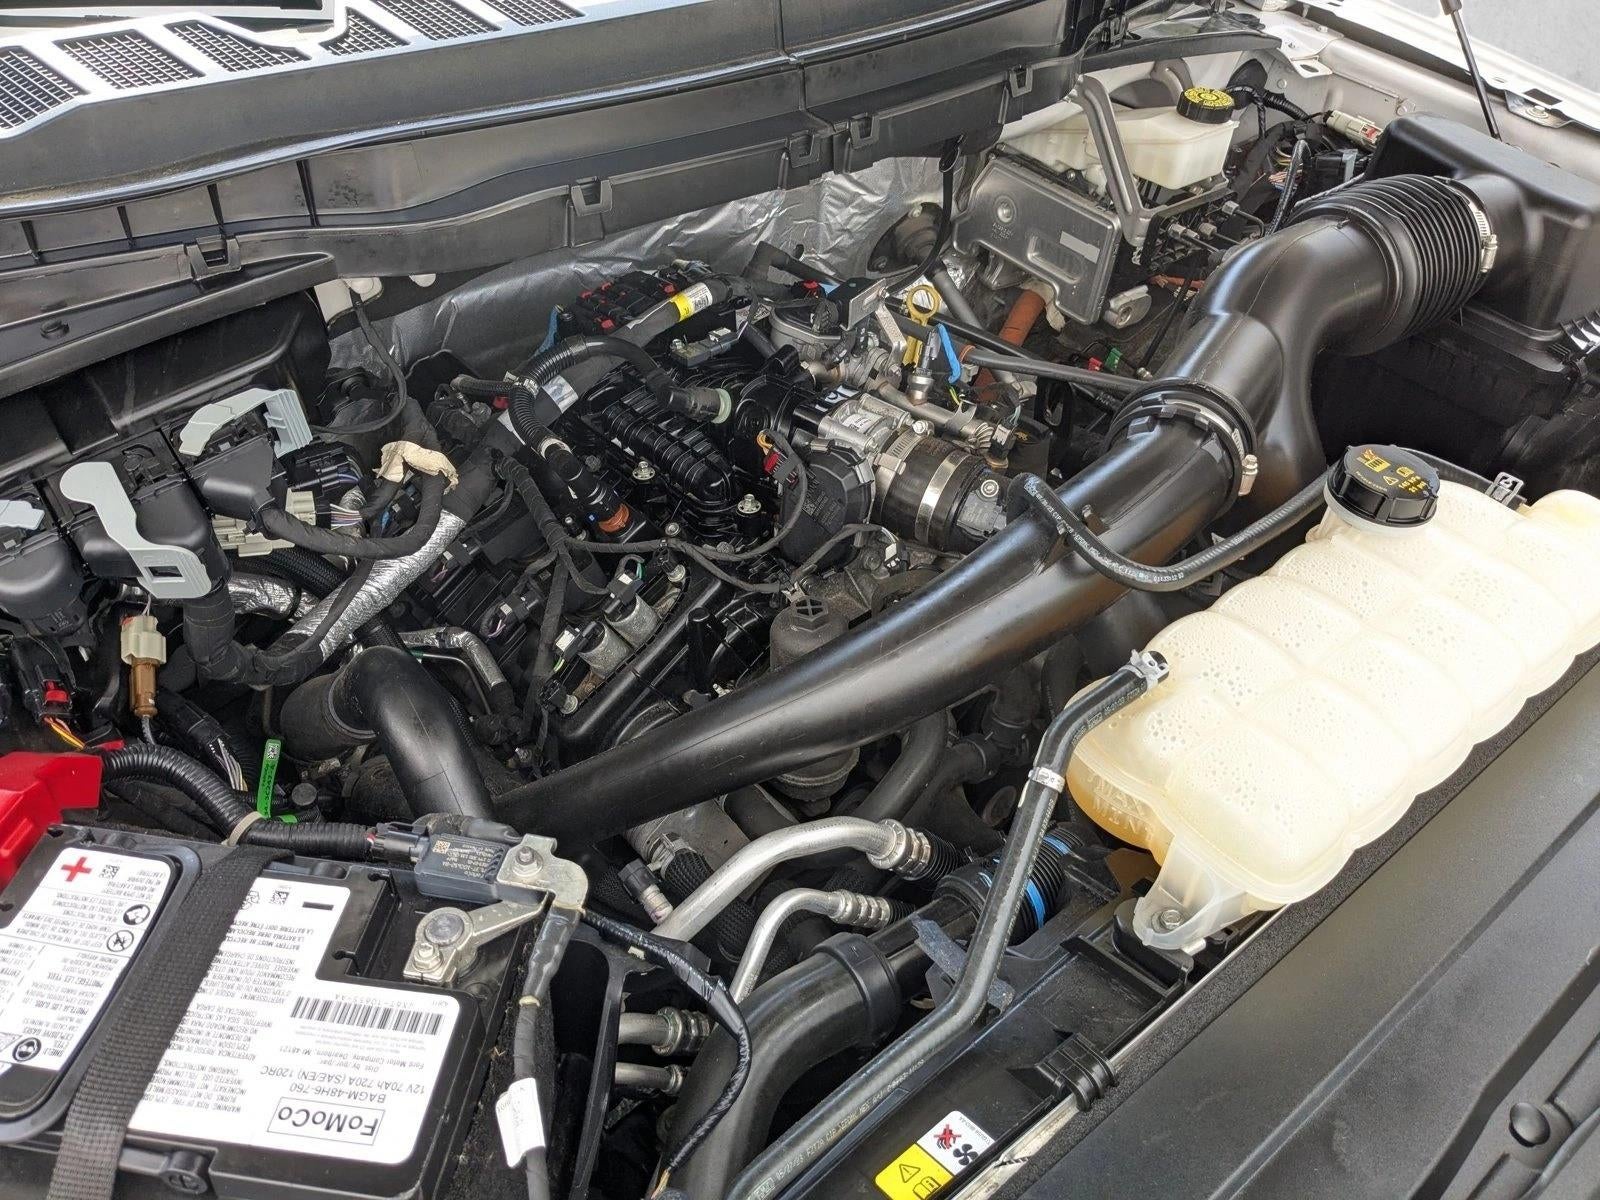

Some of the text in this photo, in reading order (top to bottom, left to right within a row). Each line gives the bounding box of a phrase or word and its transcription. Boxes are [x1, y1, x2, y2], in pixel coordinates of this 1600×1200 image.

[259, 1064, 294, 1077] 120RC
[297, 1069, 346, 1083] (SAE/EN)
[347, 1076, 374, 1087] 720A
[406, 1083, 425, 1093] 12V
[275, 1103, 379, 1137] FoMoCo
